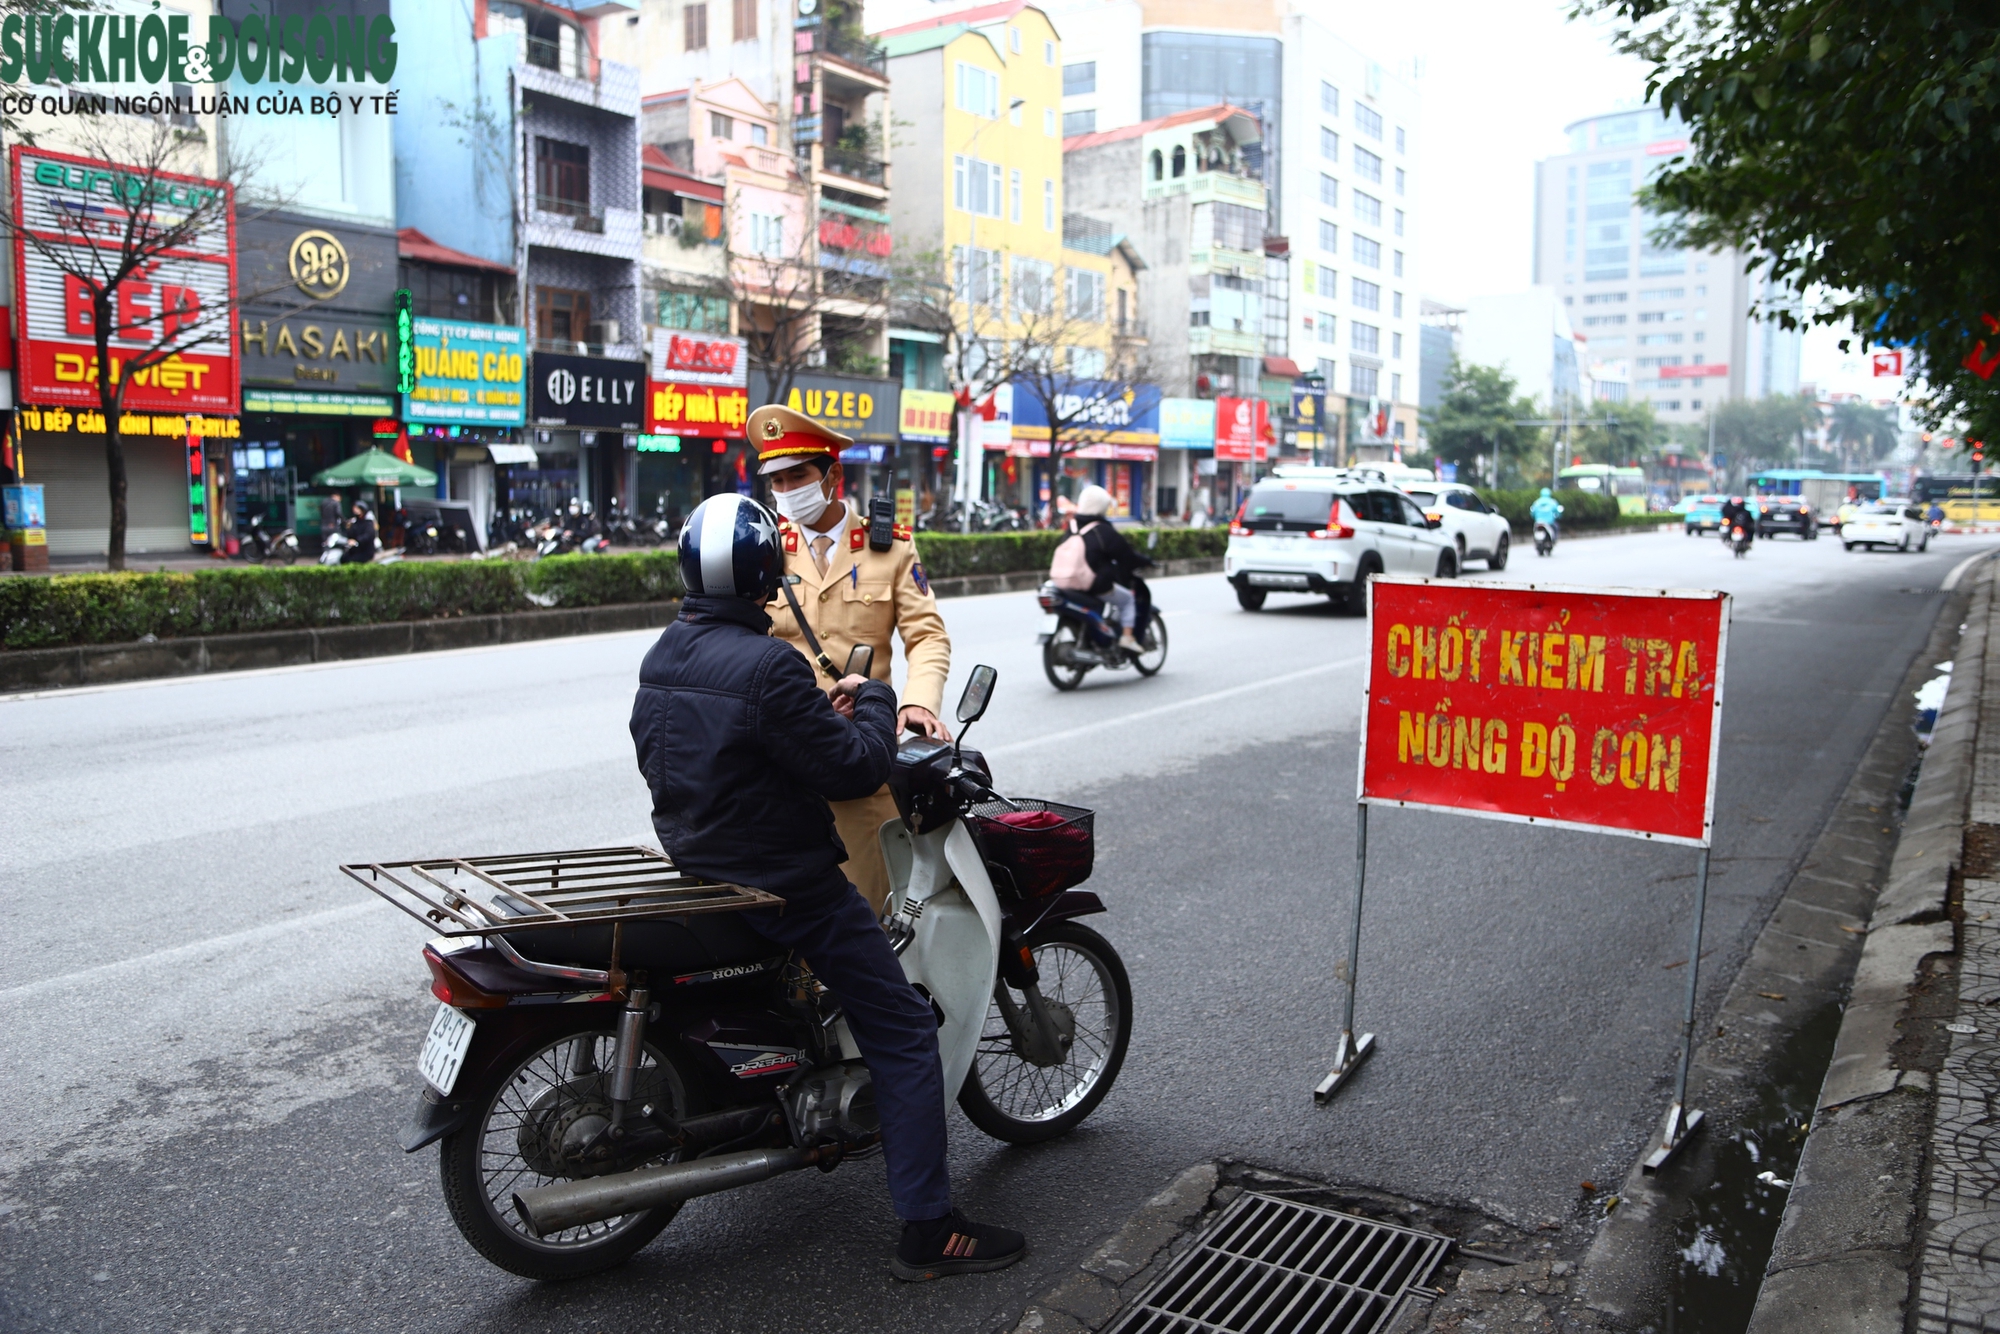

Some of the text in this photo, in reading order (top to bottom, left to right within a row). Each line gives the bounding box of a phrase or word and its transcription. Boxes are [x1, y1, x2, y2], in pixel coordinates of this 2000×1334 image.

[64, 261, 200, 344] BẾP
[241, 319, 389, 364] HASAKI
[483, 346, 523, 384] CÁO
[581, 375, 635, 406] ELLY
[653, 383, 685, 422] BẾP
[787, 387, 874, 419] AUZED
[21, 406, 42, 431] TỦ
[44, 405, 73, 433] BẾP
[76, 408, 107, 434] CÁN
[1386, 608, 1701, 701] CHỐT KIỂM TRA
[1519, 712, 1577, 793] ĐỘ
[711, 963, 764, 980] HONDA
[432, 1006, 468, 1053] 29-C1
[730, 1054, 797, 1073] DREAM
